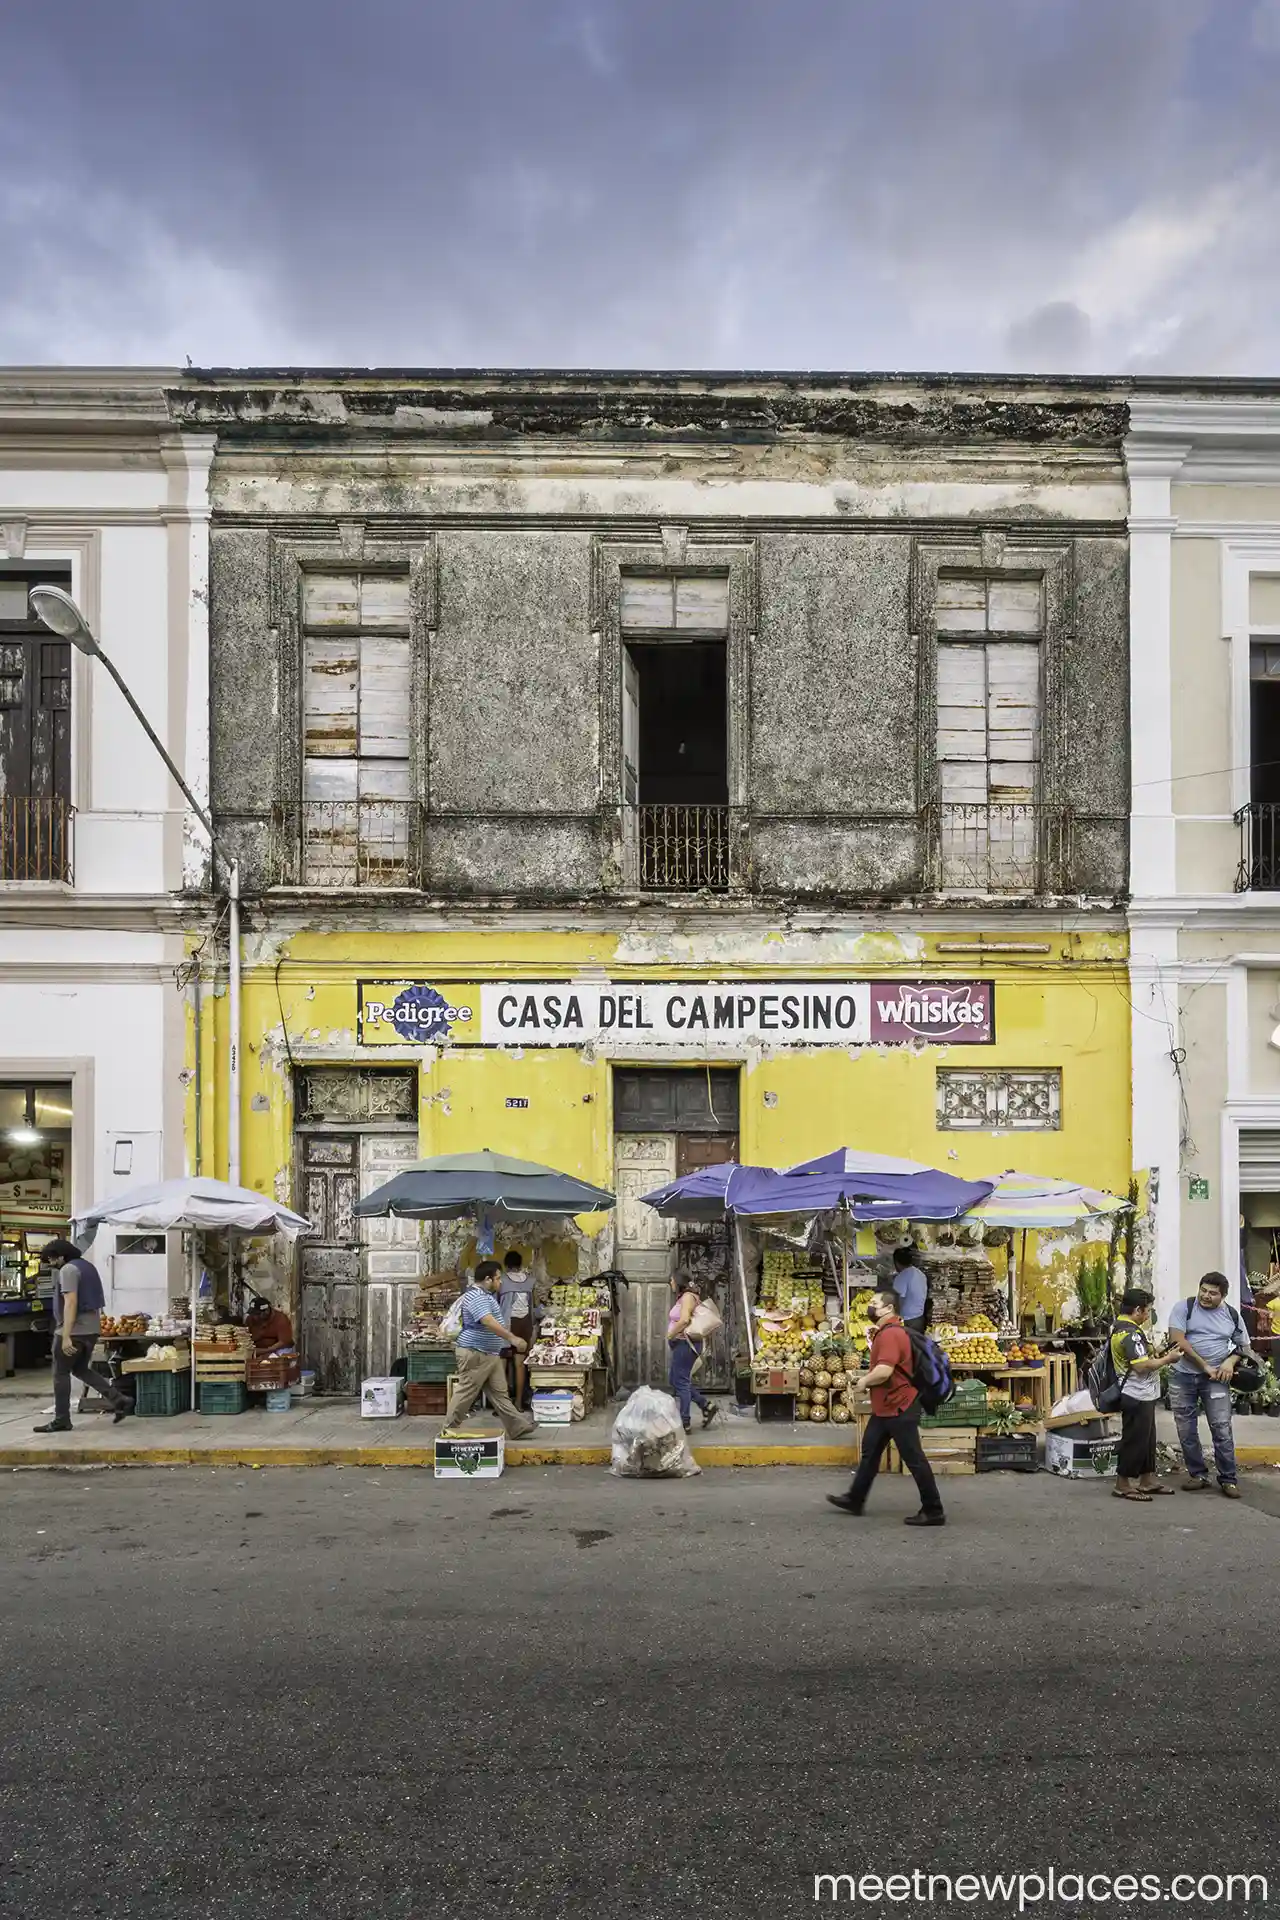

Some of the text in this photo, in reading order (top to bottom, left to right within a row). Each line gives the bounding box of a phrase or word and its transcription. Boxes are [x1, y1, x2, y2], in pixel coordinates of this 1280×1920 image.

[366, 1002, 472, 1028] Pedigree
[498, 995, 857, 1029] CASA DEL CAMPESINO
[877, 995, 984, 1023] whiskas
